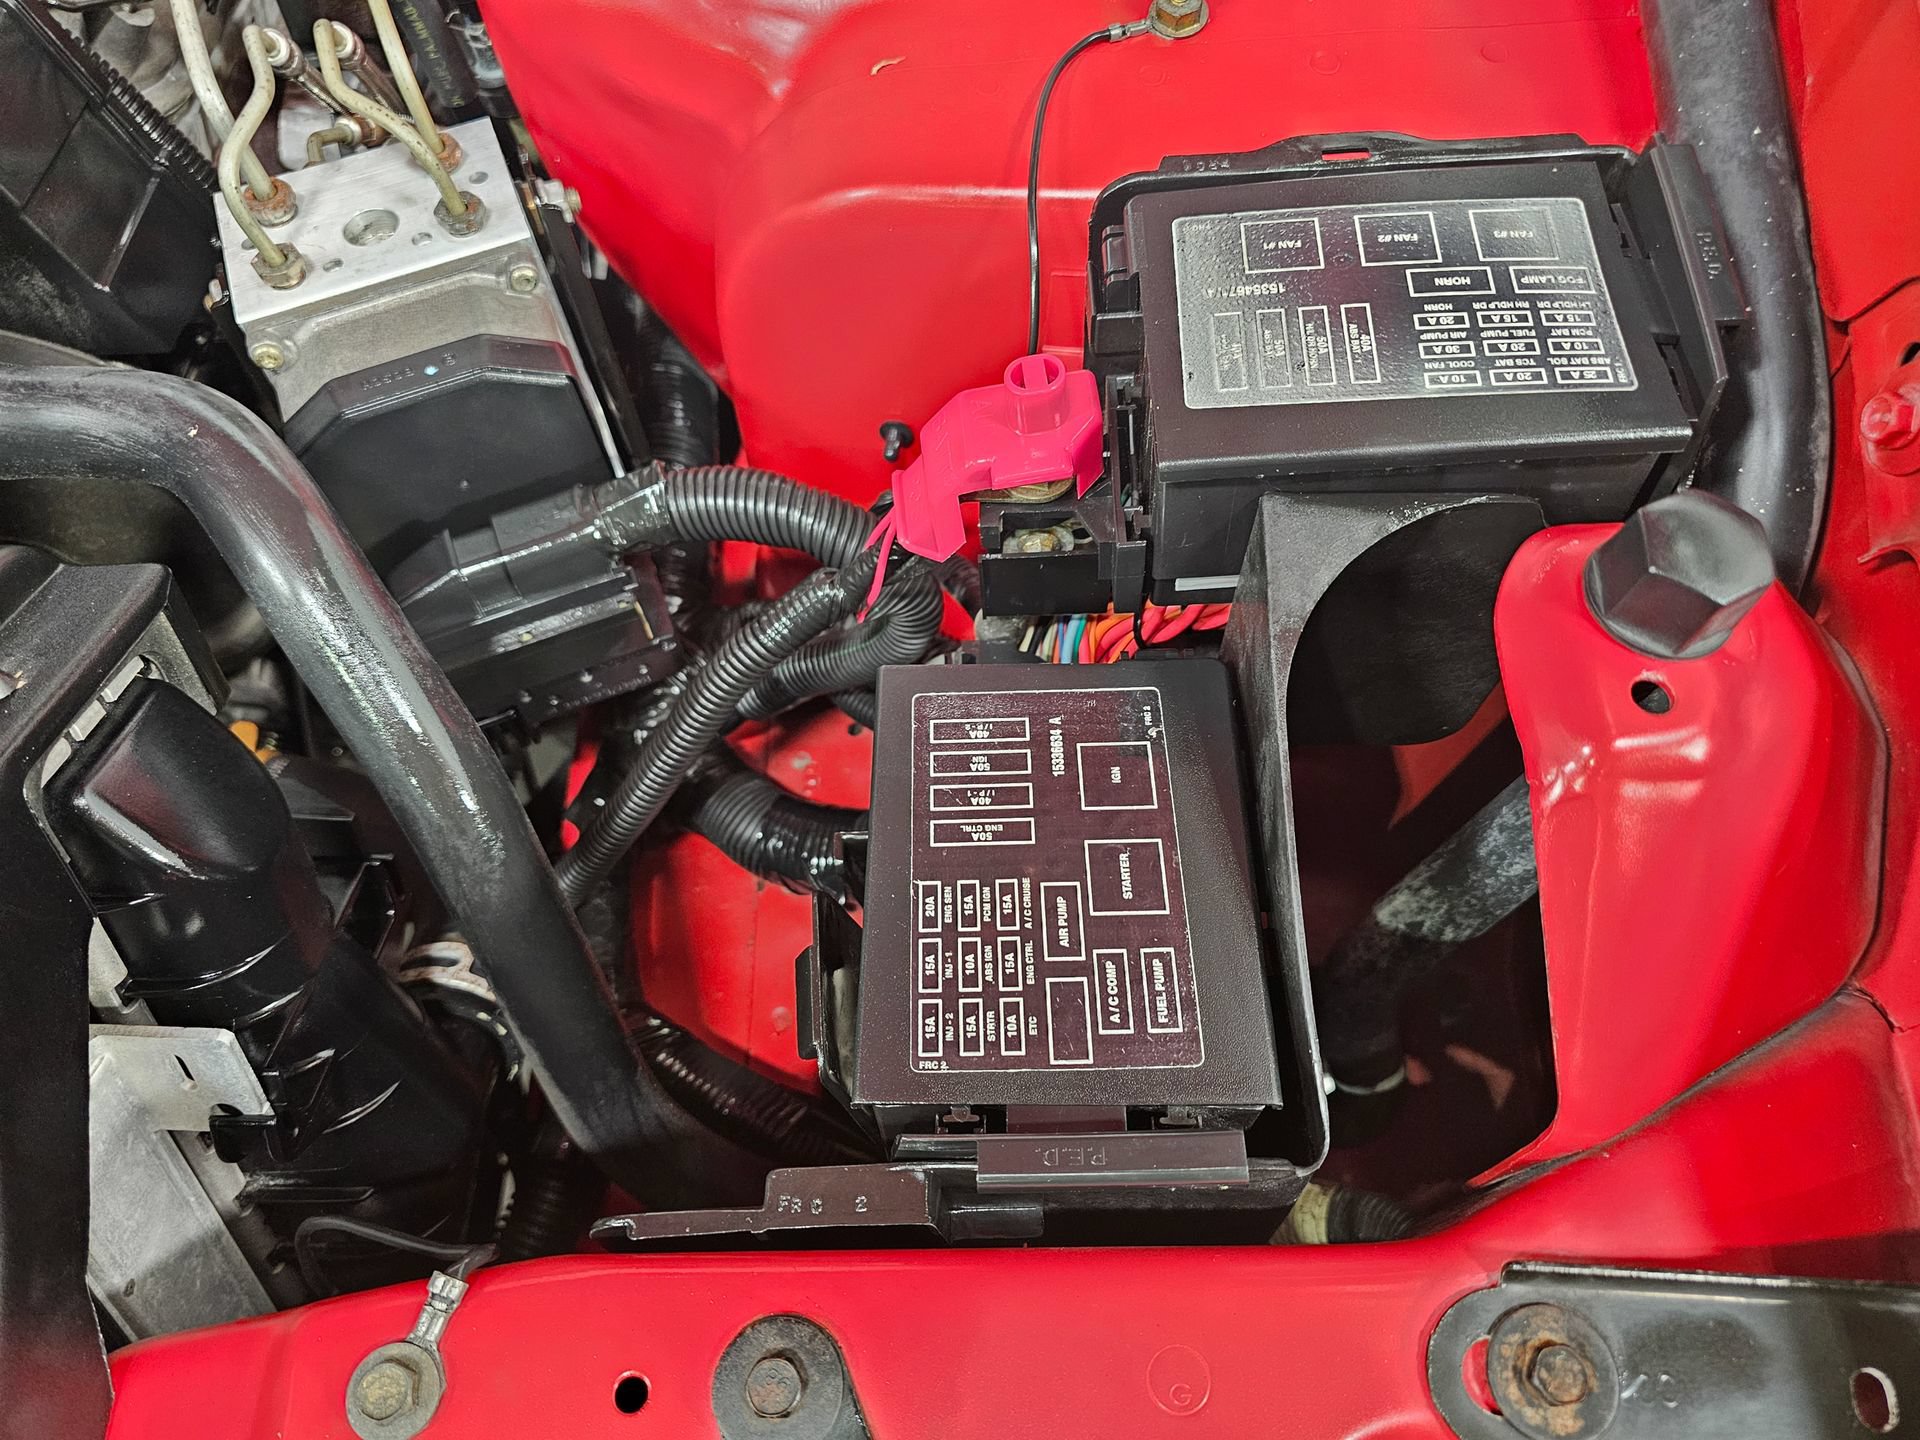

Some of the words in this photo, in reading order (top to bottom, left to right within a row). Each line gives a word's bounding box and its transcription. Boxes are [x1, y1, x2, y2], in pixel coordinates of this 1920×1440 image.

[1377, 234, 1392, 243] #2
[1393, 233, 1418, 244] FAN
[1509, 230, 1534, 239] FAN
[1263, 241, 1276, 250] #1
[1278, 239, 1302, 249] FAN
[1434, 275, 1471, 286] HORN
[1520, 275, 1556, 285] LAMP
[1556, 275, 1586, 285] FOG
[1423, 303, 1453, 312] HORN
[1472, 301, 1487, 310] DR
[1516, 300, 1530, 308] RH
[1536, 300, 1551, 309] DR
[1426, 317, 1437, 326] A
[1440, 316, 1455, 325] 20
[1491, 315, 1502, 324] A
[1505, 314, 1519, 323] 15
[1553, 315, 1564, 323] A
[1567, 314, 1581, 323] 15
[1349, 323, 1359, 339] ABS
[1420, 331, 1449, 341] PUMP
[1449, 330, 1467, 340] AIR
[1480, 329, 1508, 339] PUMP
[1509, 329, 1536, 338] FUEL
[1550, 328, 1569, 337] BAT
[1572, 328, 1593, 337] PCM
[1316, 335, 1328, 355] 50A
[1360, 333, 1371, 352] 40A
[1496, 343, 1508, 352] A
[1510, 342, 1526, 351] 20
[1561, 342, 1572, 351] A
[1574, 342, 1588, 350] 10
[1432, 345, 1443, 355] A
[1445, 345, 1460, 355] 30
[1424, 361, 1446, 370] FAN
[1446, 360, 1475, 369] COOL
[1493, 358, 1515, 367] BAT
[1569, 357, 1588, 365] BAT
[1439, 375, 1449, 384] A
[1451, 374, 1467, 383] 10
[1503, 373, 1513, 382] A
[1517, 372, 1532, 381] 20
[1569, 371, 1580, 380] A
[1582, 371, 1597, 379] 25
[1048, 716, 1063, 725] A
[1143, 711, 1153, 726] FRC
[968, 730, 991, 739] 40A
[1049, 728, 1065, 778] 15336634
[972, 756, 989, 764] IGN
[969, 763, 991, 772] 50A
[1110, 766, 1122, 784] IGN
[970, 796, 992, 806] 40A
[960, 825, 983, 833] CTRL
[984, 824, 1004, 832] ENG
[971, 832, 993, 841] 50A
[1119, 853, 1133, 900] STARTER
[943, 886, 953, 905] SEN
[982, 886, 991, 902] IGN
[1022, 877, 1032, 907] CRUISE
[925, 895, 935, 918] 20A
[963, 894, 974, 916] 15A
[1002, 893, 1013, 916] 15A
[944, 905, 953, 923] ENG
[982, 903, 992, 922] PCM
[1056, 895, 1069, 927] PUMP
[1057, 927, 1070, 948] AIR
[983, 945, 993, 963] IGN
[1025, 940, 1035, 966] CTRL
[925, 954, 936, 976] 15A
[964, 953, 975, 976] 10A
[1004, 952, 1015, 975] 15A
[984, 963, 994, 982] ABS
[1026, 967, 1036, 985] ENG
[1105, 960, 1119, 994] COMP
[1152, 958, 1166, 992] PUMP
[1155, 992, 1169, 1024] FUEL
[925, 1015, 936, 1039] 15A
[965, 1014, 977, 1039] 15A
[987, 1010, 996, 1042] STRTR
[1006, 1014, 1018, 1039] 10A
[1028, 1015, 1038, 1036] ETC
[918, 1060, 938, 1070] FRC
[777, 1194, 823, 1215] FRC
[855, 1195, 868, 1213] 2
[1168, 1383, 1193, 1406] G
